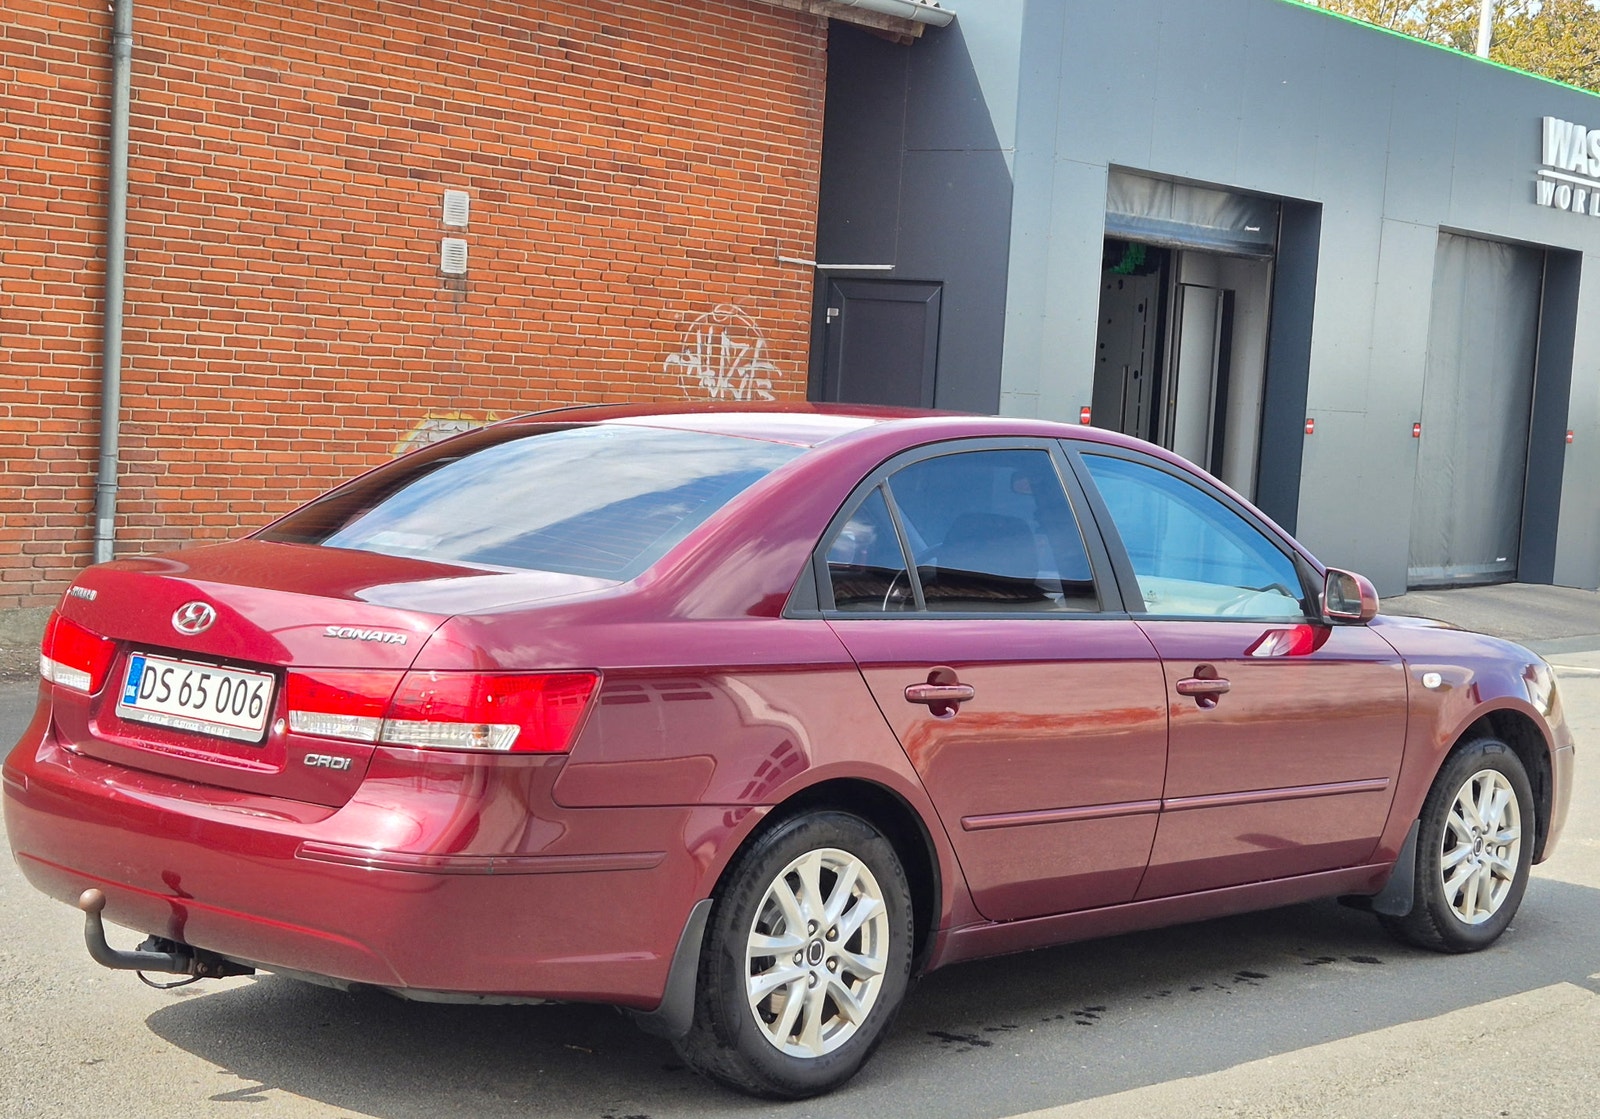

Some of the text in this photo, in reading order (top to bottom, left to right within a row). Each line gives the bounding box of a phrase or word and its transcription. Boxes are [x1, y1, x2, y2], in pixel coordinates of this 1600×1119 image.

[323, 625, 408, 645] SONATA
[139, 665, 264, 719] DS 65 006
